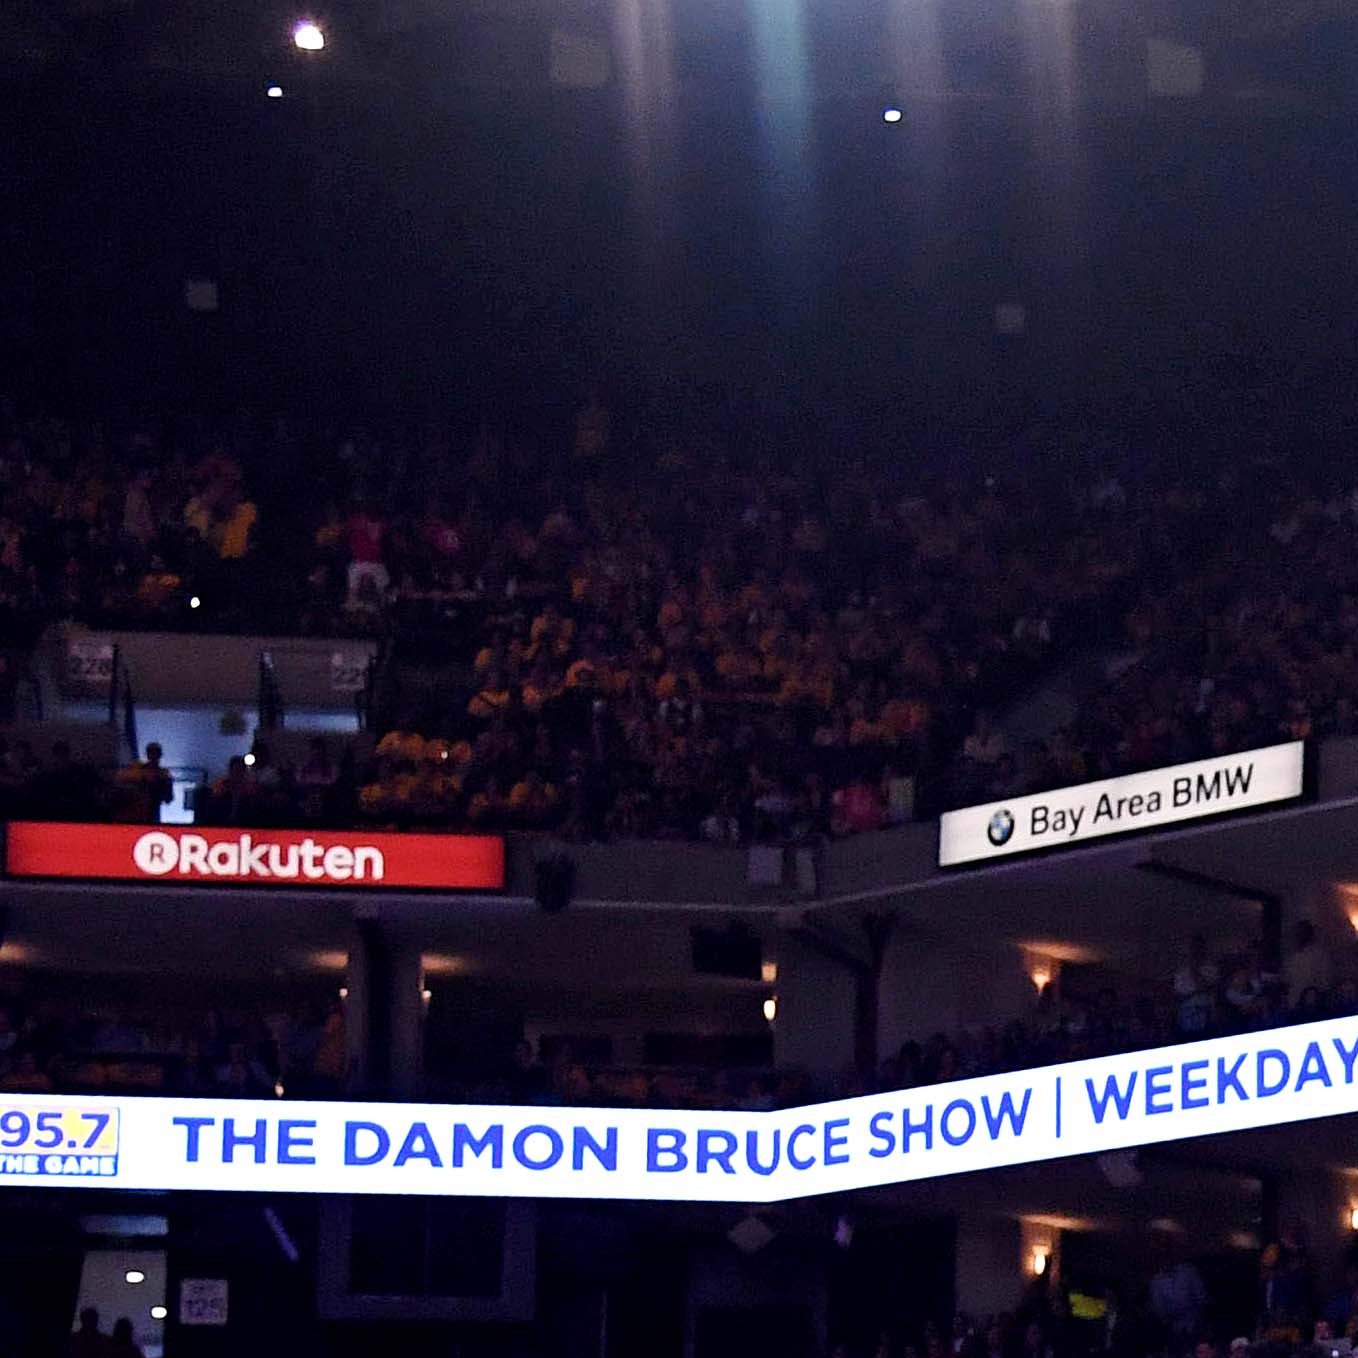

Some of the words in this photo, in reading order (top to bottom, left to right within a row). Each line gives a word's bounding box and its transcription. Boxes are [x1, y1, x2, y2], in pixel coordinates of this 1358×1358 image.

[1030, 806, 1084, 836] Bay
[1093, 793, 1161, 824] Area
[1172, 763, 1254, 808] BMW
[179, 833, 384, 880] Rakuten
[0, 1110, 110, 1149] 95.7
[172, 1116, 317, 1166] THE
[343, 1120, 619, 1172] DAMON
[645, 1111, 851, 1177] BRUCE
[868, 1087, 1033, 1159] SHOW
[0, 1154, 39, 1174] HE
[44, 1155, 115, 1175] GAME
